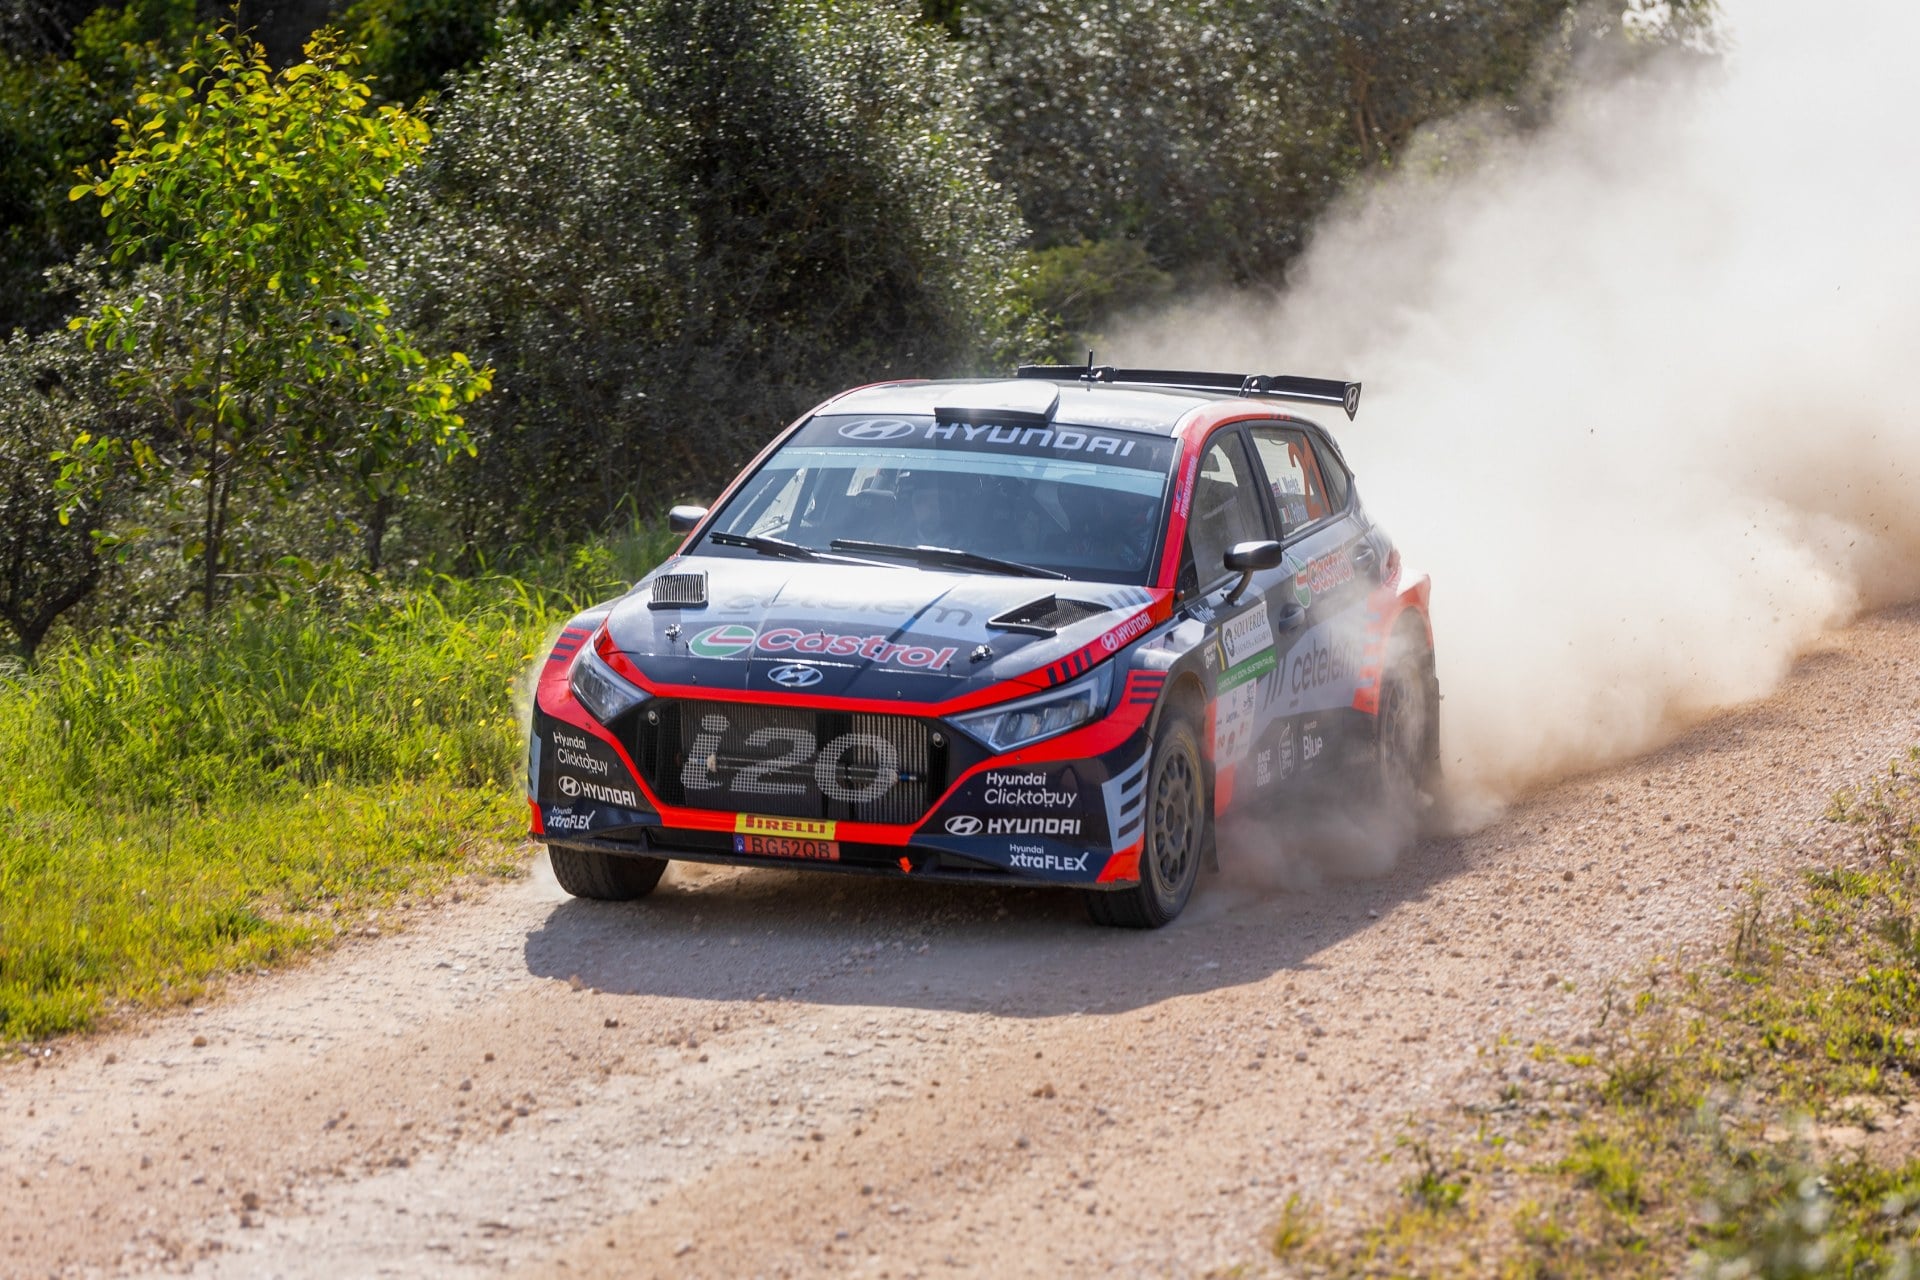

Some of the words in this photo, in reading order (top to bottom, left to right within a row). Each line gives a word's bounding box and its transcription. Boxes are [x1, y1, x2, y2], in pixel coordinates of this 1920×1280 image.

[924, 422, 1136, 457] HYUNDAI
[1307, 542, 1355, 594] Castrol
[1115, 611, 1152, 642] HYUNDAI
[757, 628, 958, 669] Castrol
[553, 731, 587, 750] Hyundai
[1303, 734, 1323, 761] Blue
[681, 714, 899, 803] i20
[986, 772, 1047, 787] Hyundai
[581, 781, 637, 807] HYUNDAI
[547, 810, 596, 830] xtraFLEX
[552, 805, 573, 815] Hyundai
[745, 814, 826, 834] PIRELLI
[987, 818, 1081, 835] HYUNDAI
[752, 837, 831, 860] BG52QB
[1009, 843, 1044, 854] Hyundai
[1009, 852, 1089, 871] xtraFLEX
